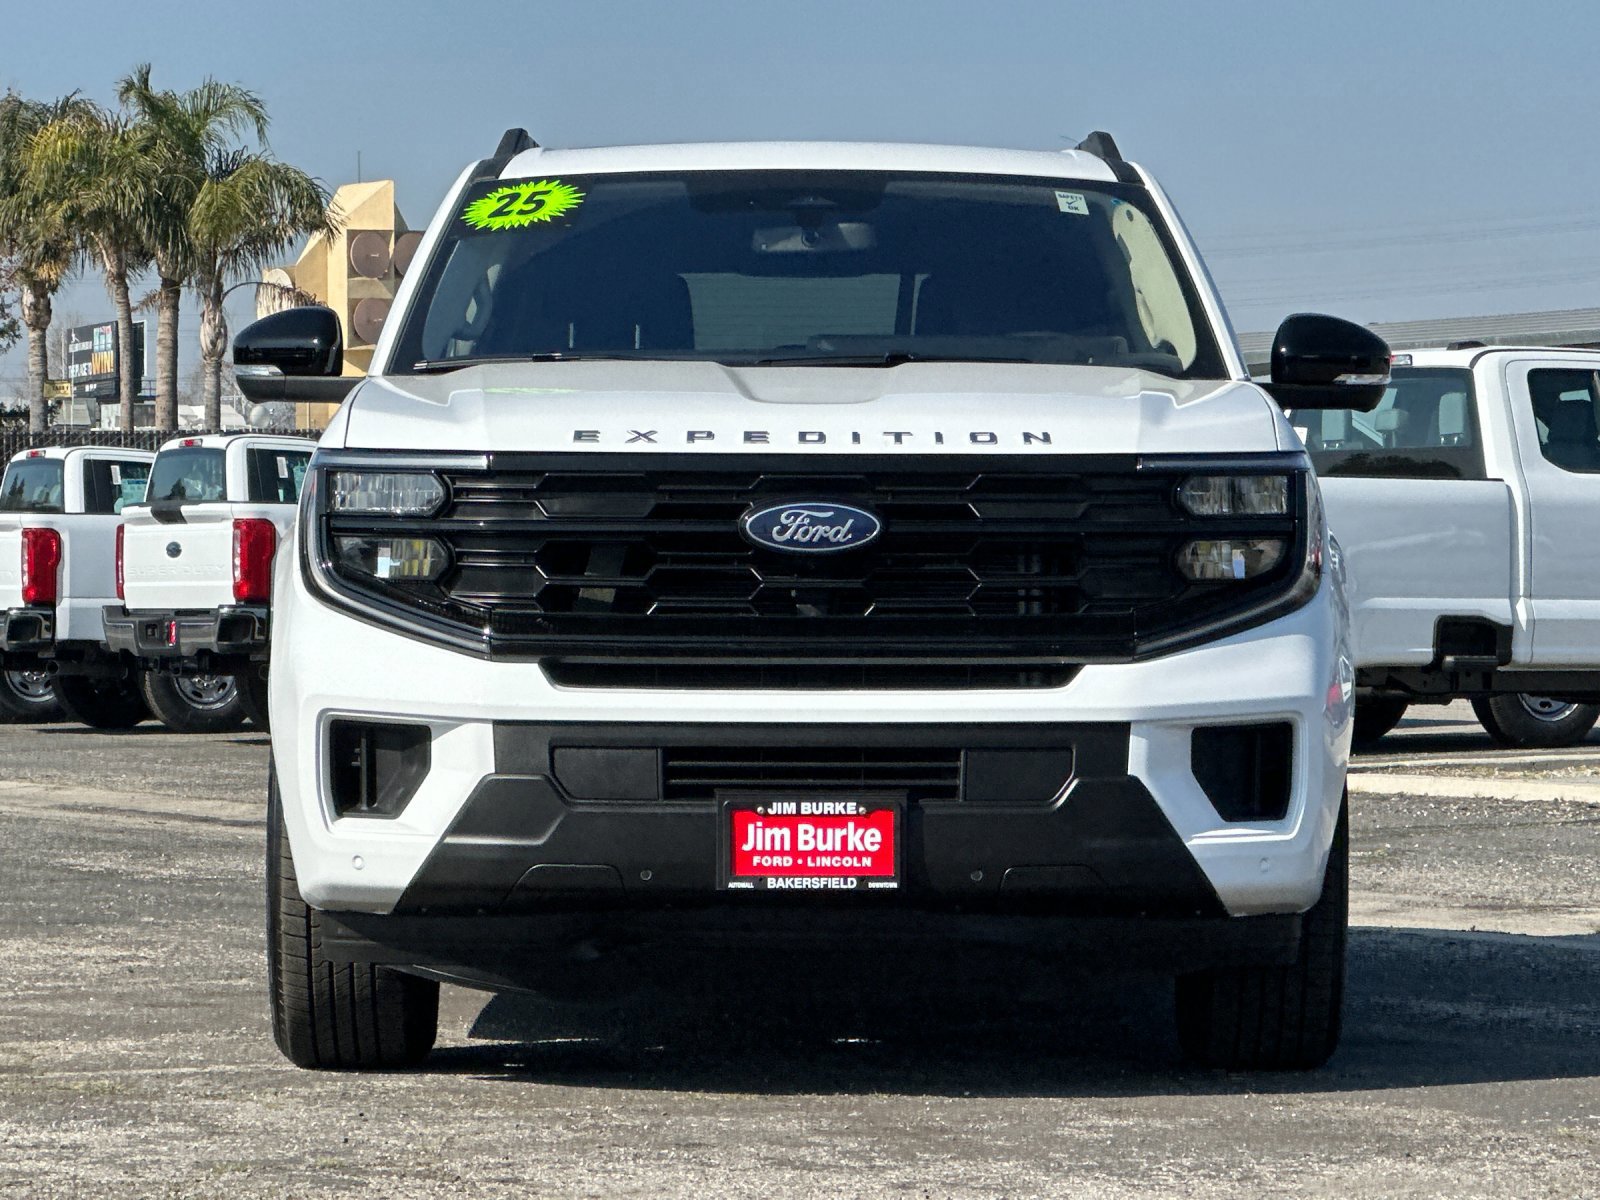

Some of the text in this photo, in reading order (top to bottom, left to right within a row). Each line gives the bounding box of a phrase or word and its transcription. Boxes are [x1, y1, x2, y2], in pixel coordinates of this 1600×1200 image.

[487, 190, 552, 218] 25
[92, 350, 114, 375] WIN!
[573, 430, 1053, 445] EXPEDITION
[771, 509, 853, 544] Ford
[767, 802, 857, 815] JIM BURKE
[742, 822, 882, 851] Jim Burke
[753, 856, 872, 867] FORD LINCOLN
[767, 877, 857, 889] BAKERSFIELD
